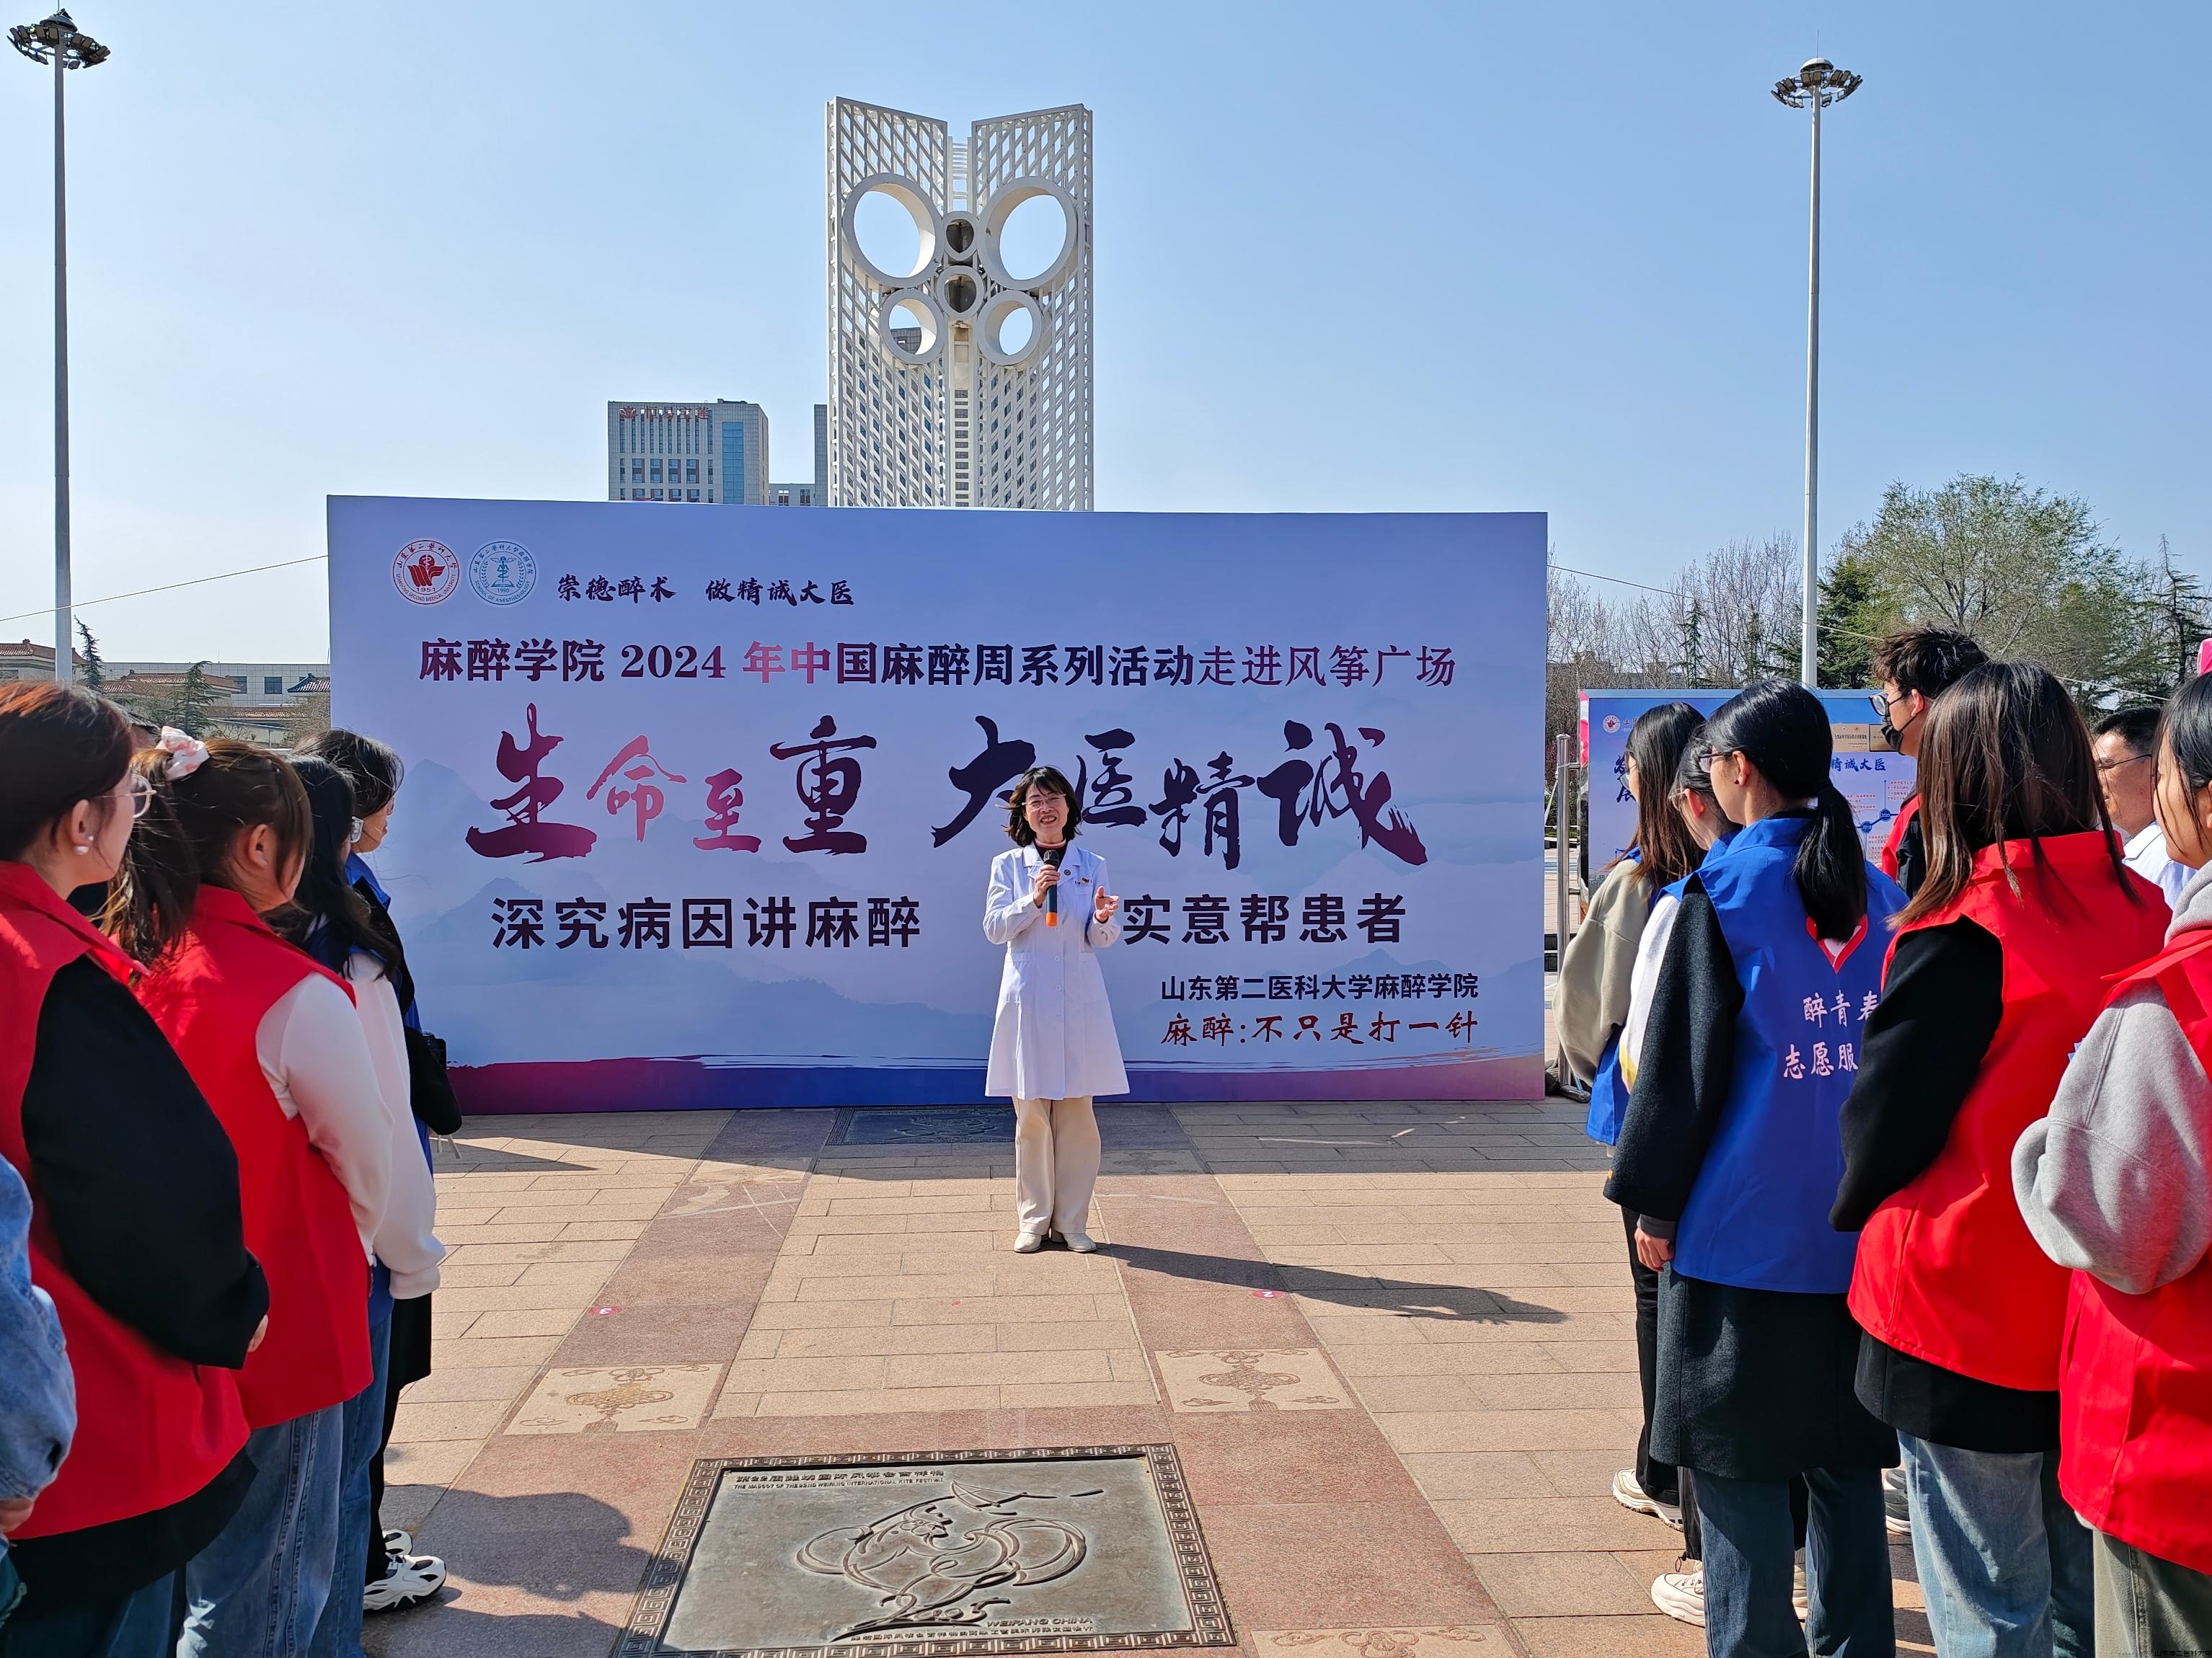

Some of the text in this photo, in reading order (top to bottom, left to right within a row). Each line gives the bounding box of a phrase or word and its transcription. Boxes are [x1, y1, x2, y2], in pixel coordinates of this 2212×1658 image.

[705, 577, 854, 606] 做精诚大医
[420, 638, 1455, 688] 麻醉学院 2024 年中国麻醉周系列活动走进风筝广场
[465, 703, 1428, 869] 生命至重 大医精诚
[491, 896, 920, 949] 深究病因讲麻醉
[1162, 972, 1479, 1001] 山东第二医科大学麻醉学院
[1783, 1041, 1859, 1079] 志愿服
[986, 1618, 1049, 1628] WEIFANG
